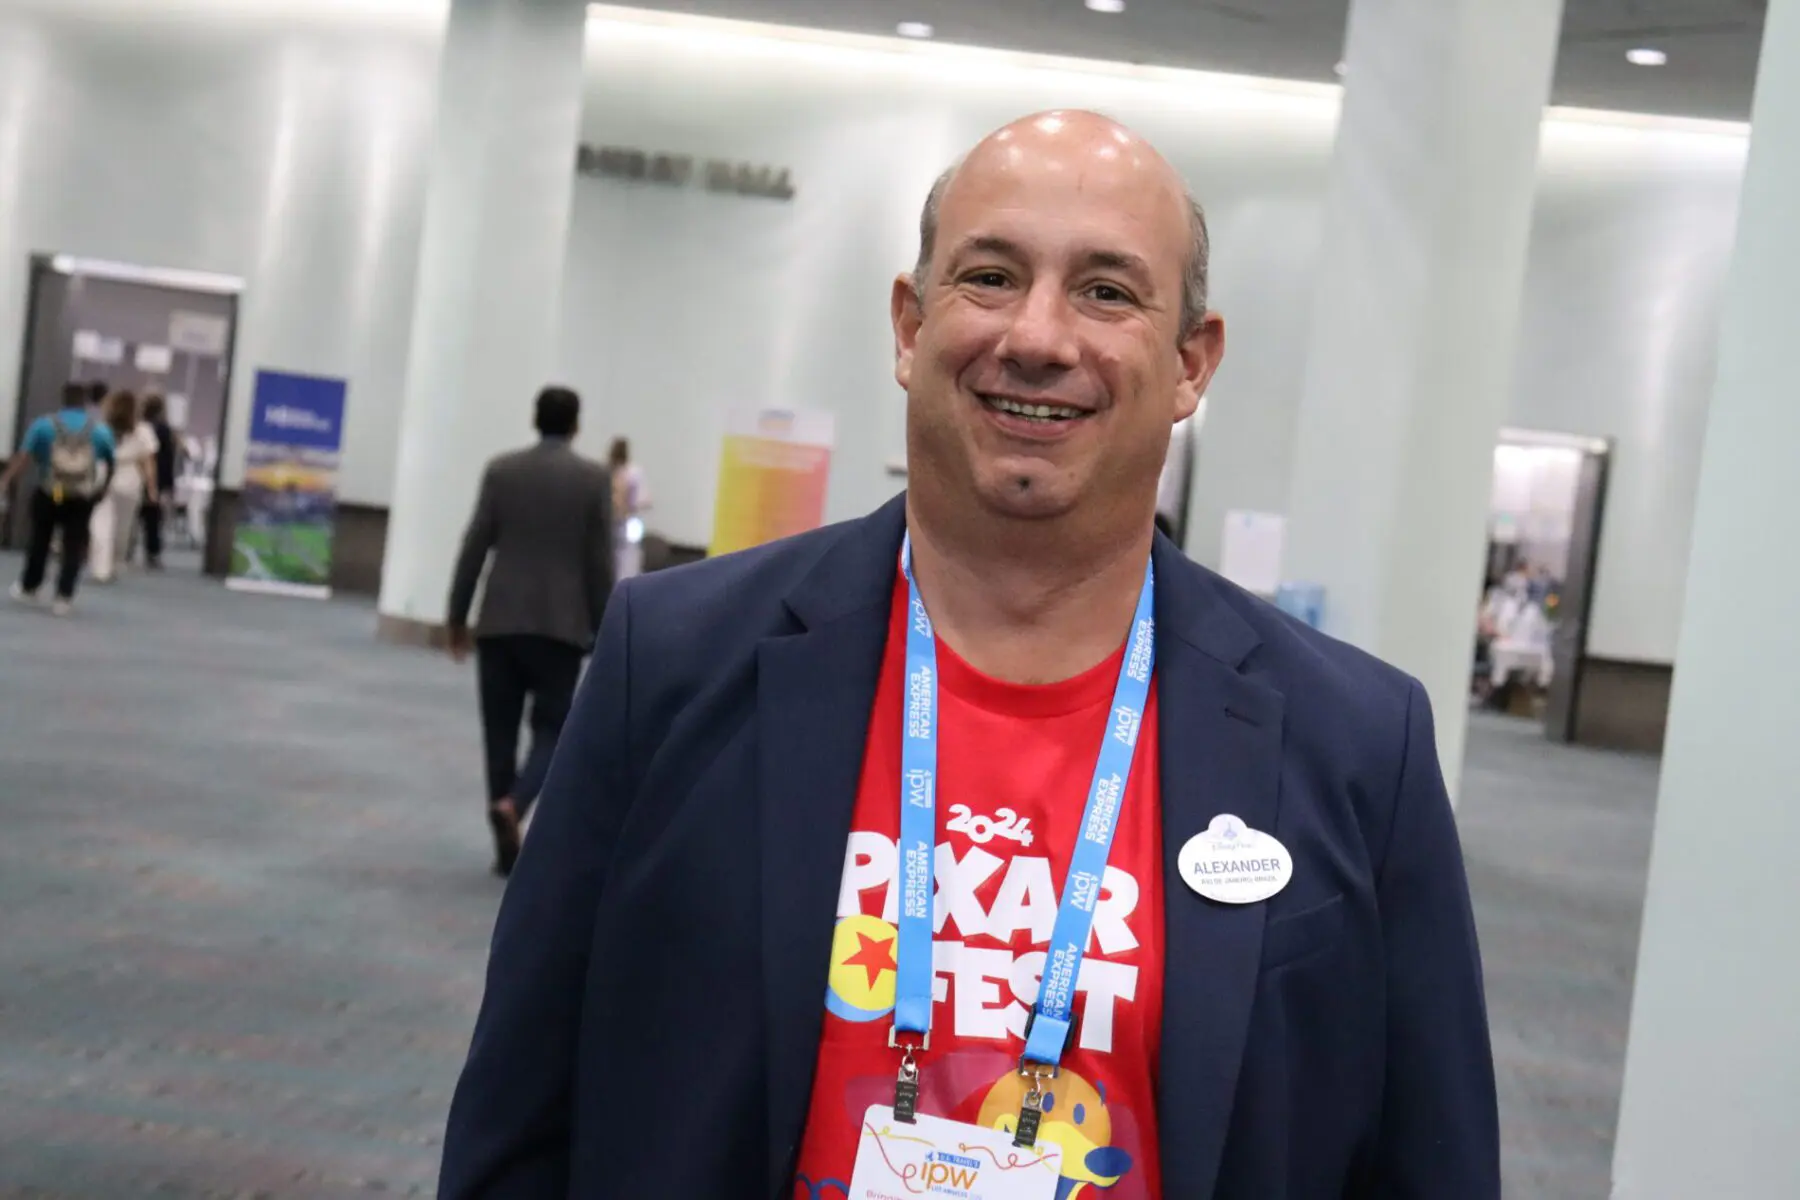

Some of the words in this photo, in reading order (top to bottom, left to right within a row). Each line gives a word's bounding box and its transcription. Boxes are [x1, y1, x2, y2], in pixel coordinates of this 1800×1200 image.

[1127, 619, 1147, 678] EXPRESS
[1136, 616, 1155, 684] AMERICAN
[909, 673, 921, 738] EXPRESS
[920, 665, 931, 740] AMERICAN
[946, 803, 1034, 847] 2024
[1085, 778, 1109, 842] EXPRESS
[1096, 772, 1121, 846] AMERICAN
[904, 849, 917, 918] EXPRESS
[915, 841, 929, 919] AMERICAN
[1194, 858, 1281, 875] ALEXANDER
[1042, 949, 1065, 1016] EXPRESS
[1054, 942, 1078, 1019] AMERICAN
[921, 1162, 978, 1190] ipw
